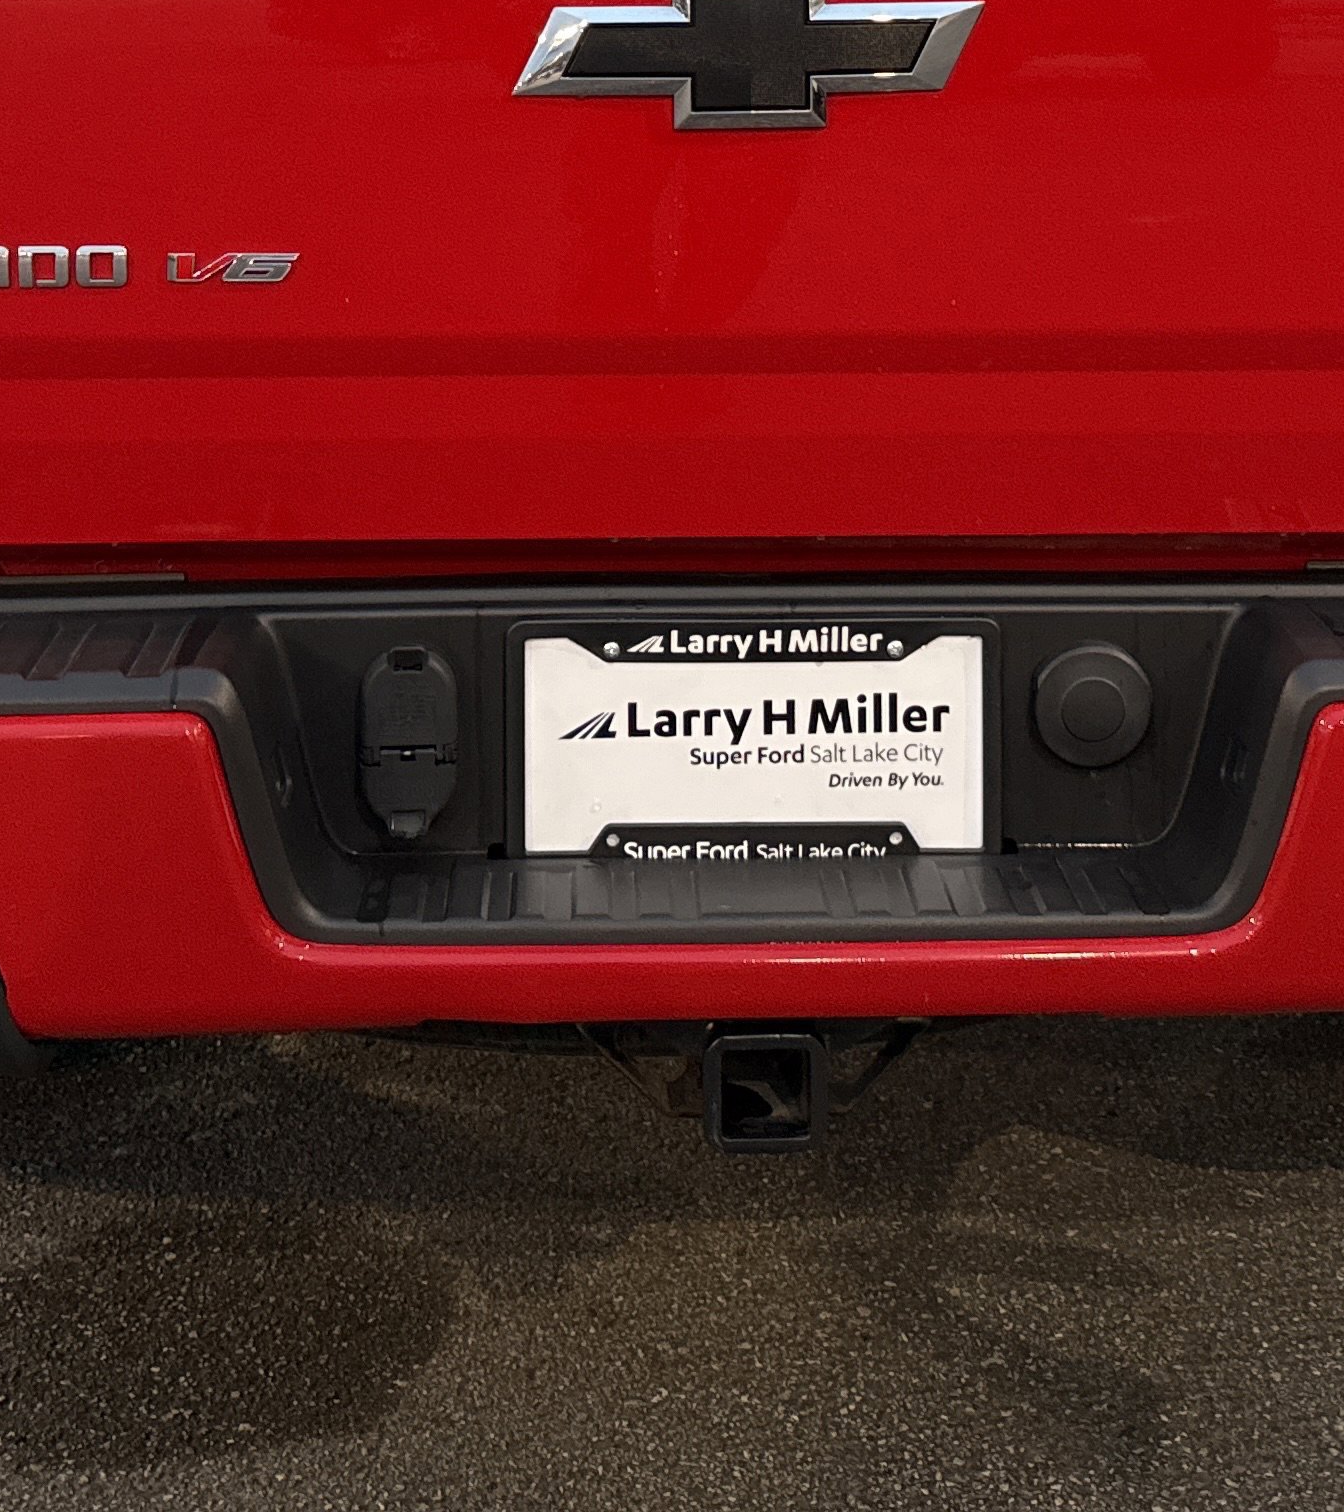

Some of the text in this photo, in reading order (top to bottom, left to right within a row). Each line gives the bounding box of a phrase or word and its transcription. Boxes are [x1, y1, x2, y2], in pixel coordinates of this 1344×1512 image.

[165, 251, 301, 283] V6
[670, 626, 883, 659] Larry H Miller
[627, 692, 950, 745] Larry H Miller
[689, 742, 944, 769] Super Ford Salt Lake City
[828, 772, 883, 788] Driven
[888, 773, 908, 790] By
[696, 840, 748, 859] Ford
